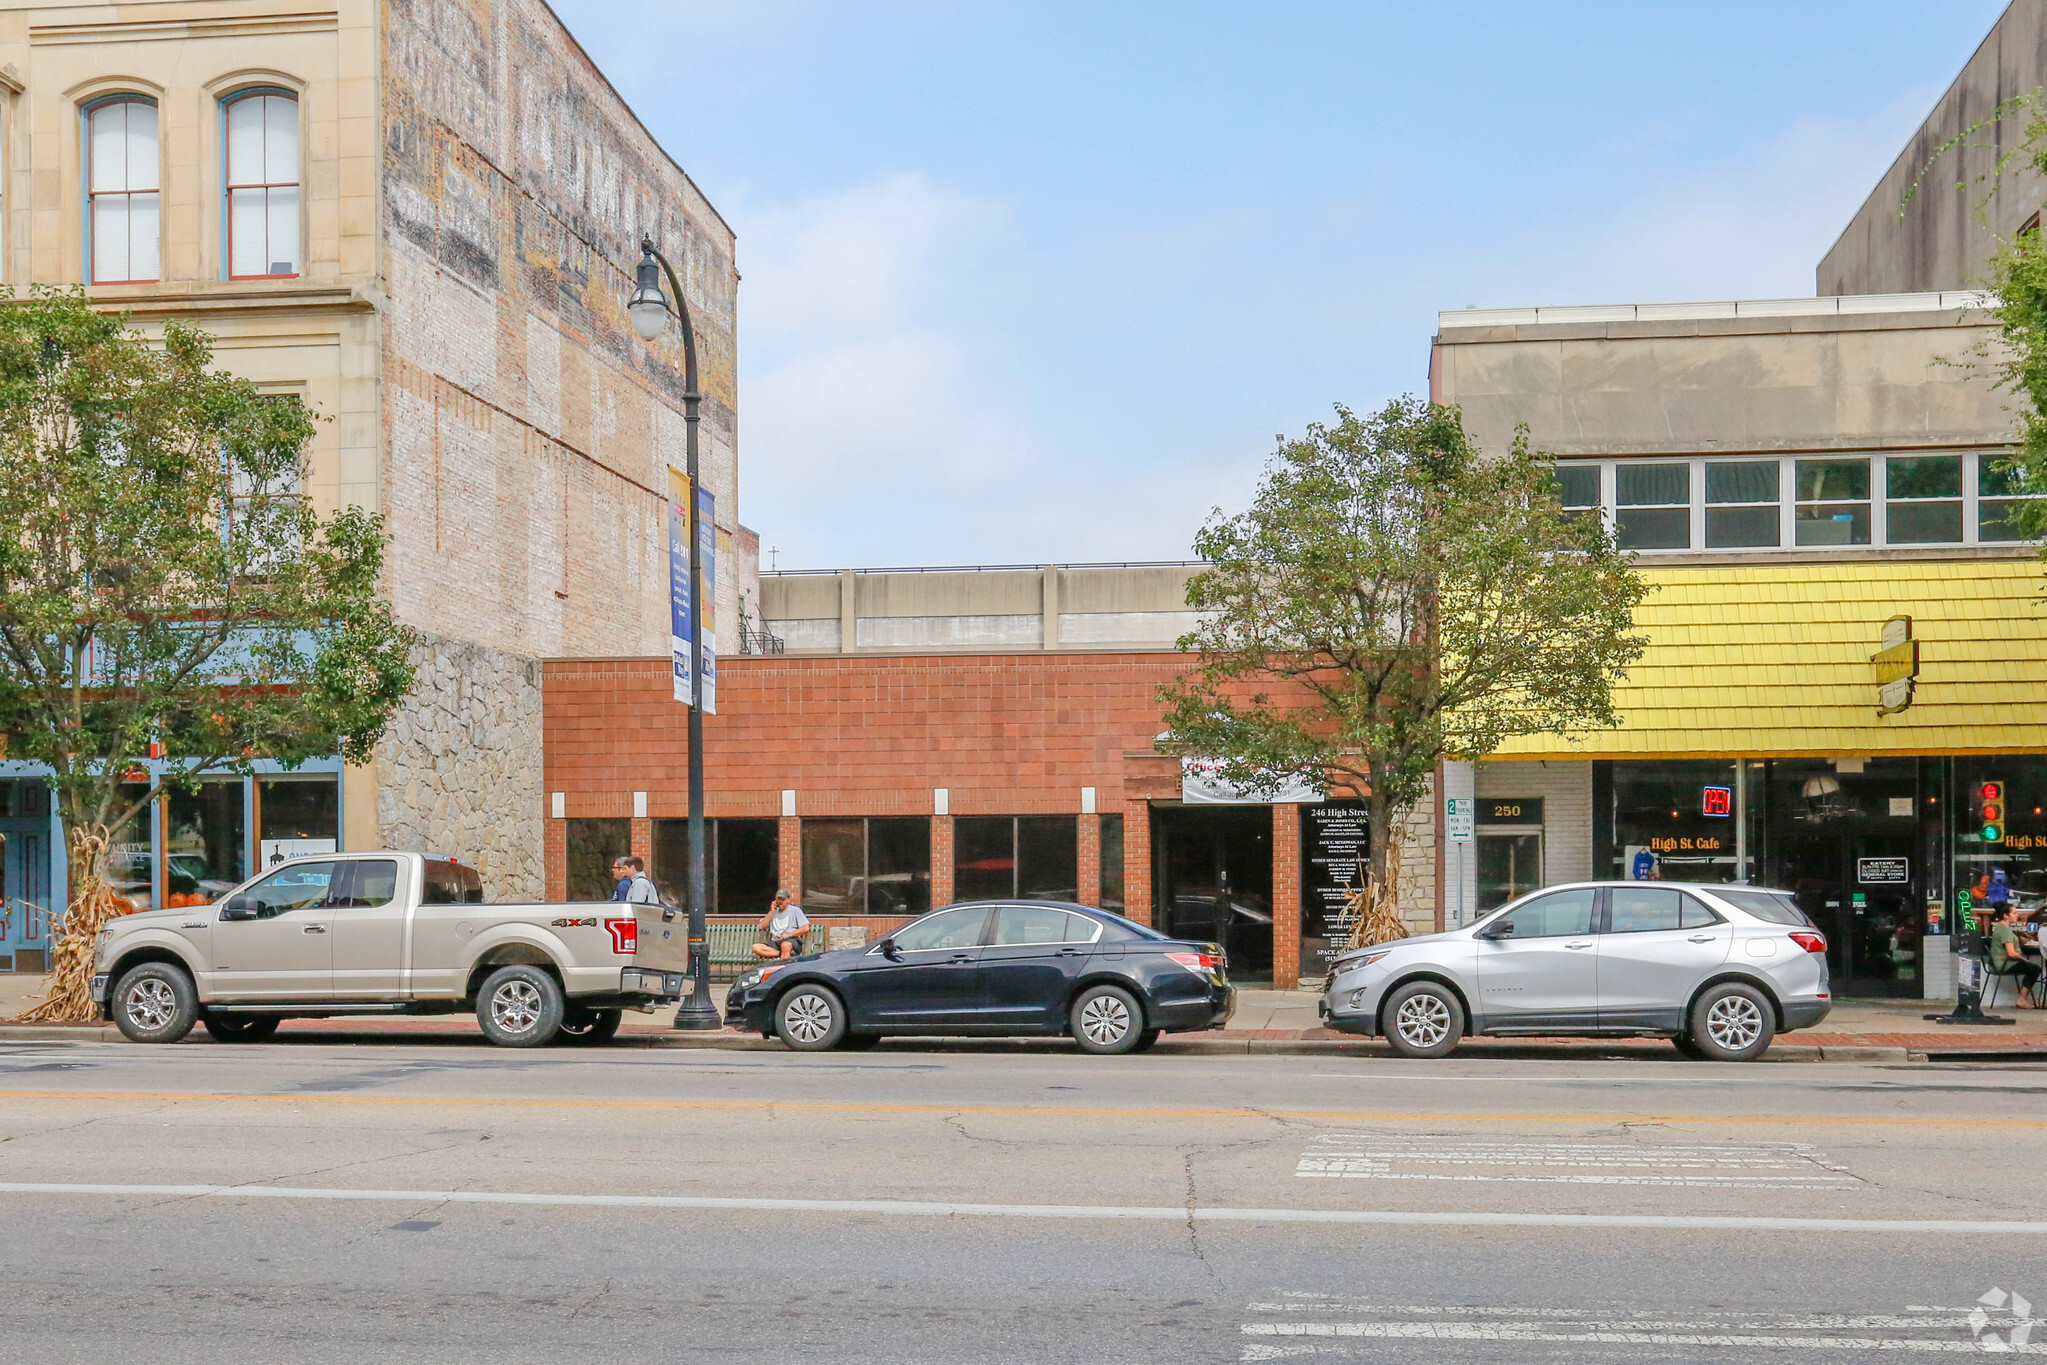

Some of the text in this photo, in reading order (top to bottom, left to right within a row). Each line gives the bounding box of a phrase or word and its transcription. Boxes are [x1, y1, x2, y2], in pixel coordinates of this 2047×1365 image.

[1187, 762, 1221, 771] Office
[1448, 801, 1455, 814] 2
[1704, 789, 1730, 814] OPEN
[1327, 809, 1347, 818] High
[1495, 805, 1521, 817] 250
[1651, 837, 1720, 852] High St. Cafe
[2006, 835, 2032, 850] High
[1958, 889, 1978, 931] OPEN
